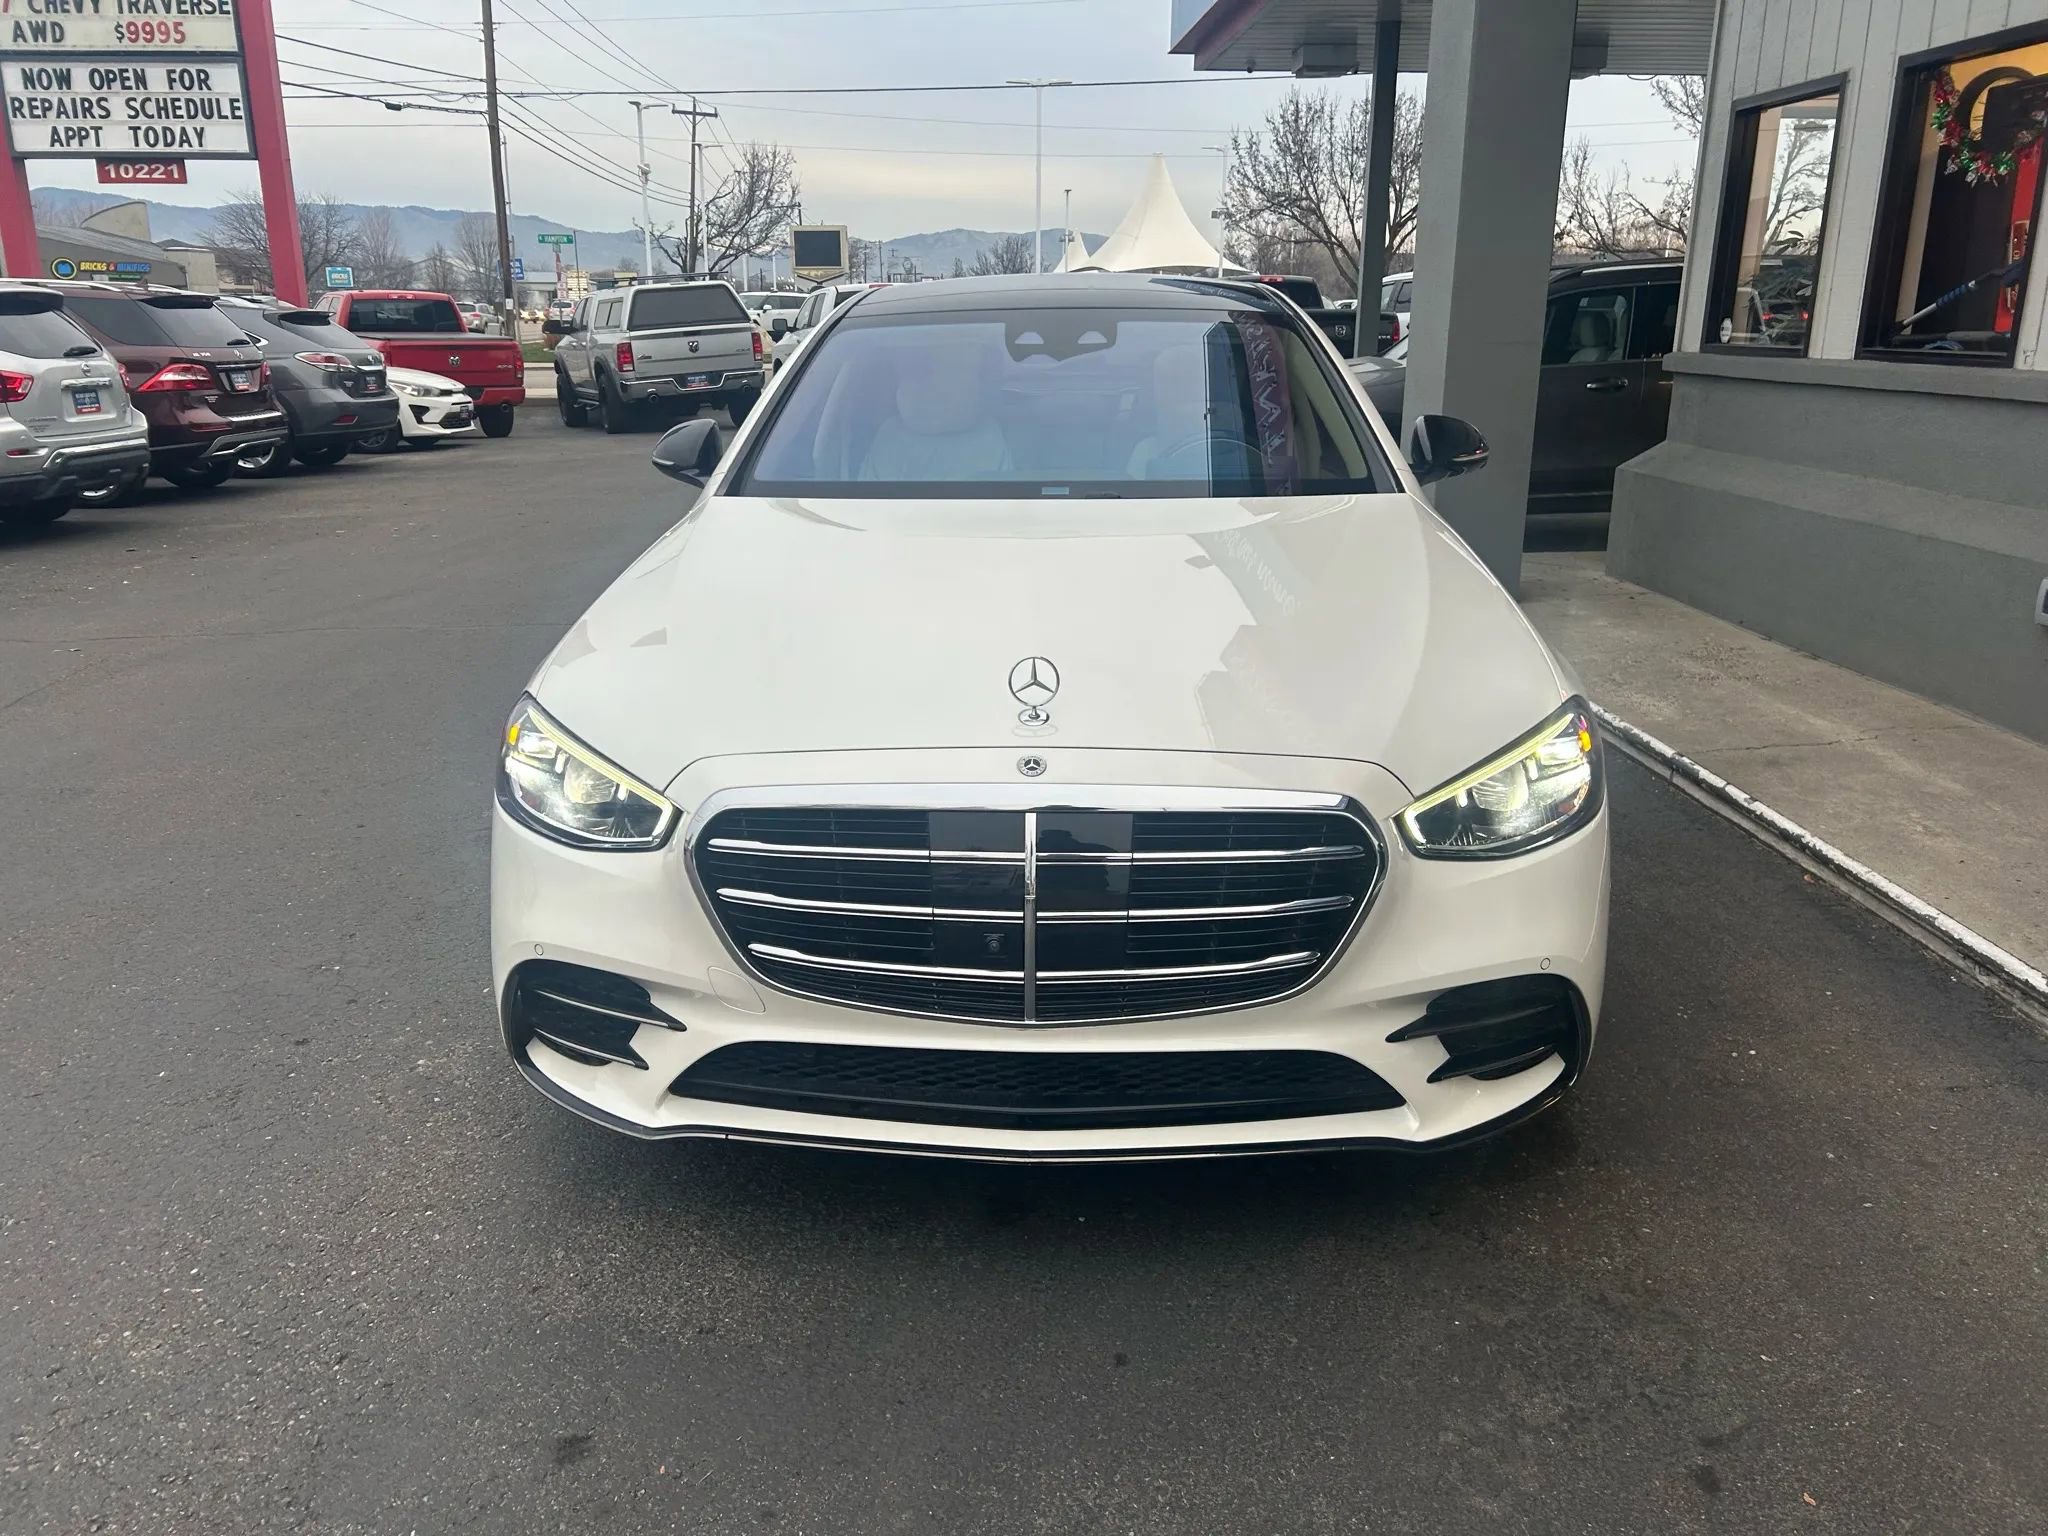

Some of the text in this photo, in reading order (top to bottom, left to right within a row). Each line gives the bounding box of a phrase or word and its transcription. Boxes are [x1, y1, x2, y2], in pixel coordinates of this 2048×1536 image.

[27, 0, 100, 14] CHEVY
[116, 0, 231, 15] TRAVERSE
[12, 20, 186, 44] AWD $9995
[21, 67, 212, 91] NOW OPEN FOR
[9, 96, 243, 120] REPAIRS SCHEDULE
[50, 125, 205, 148] APPT TODAY
[104, 163, 179, 179] 10221
[80, 261, 107, 271] BRICKS
